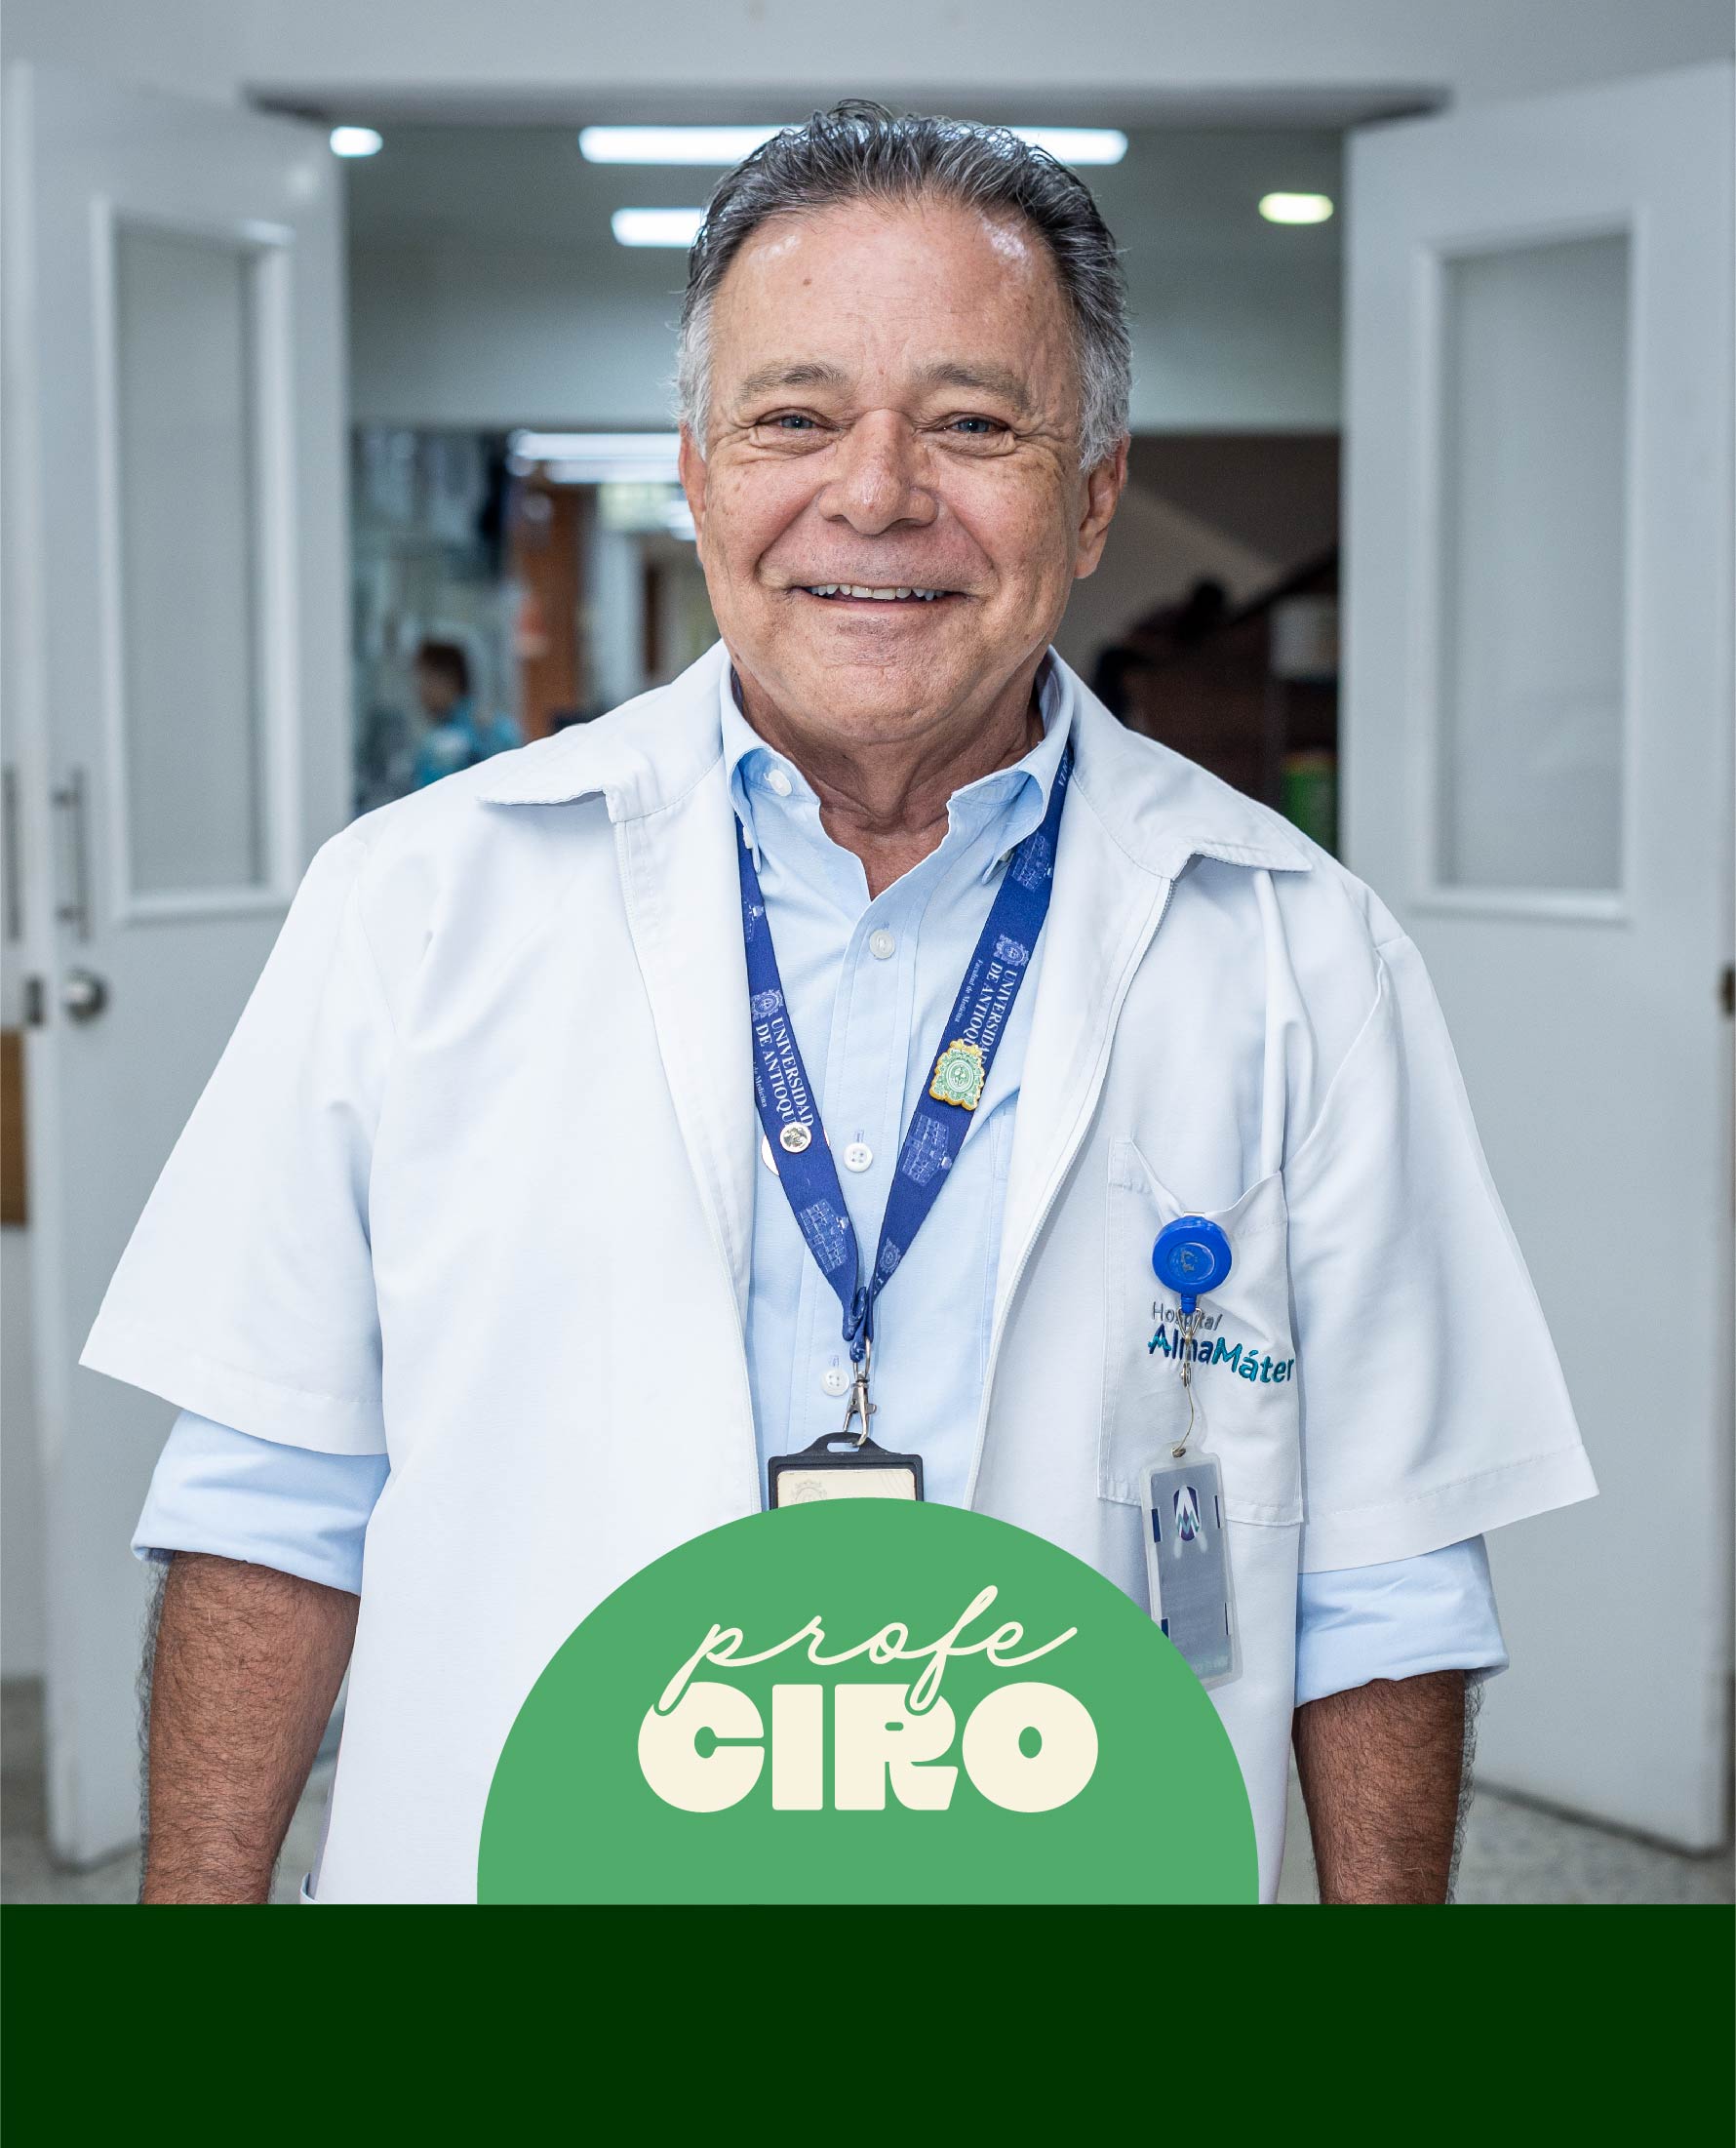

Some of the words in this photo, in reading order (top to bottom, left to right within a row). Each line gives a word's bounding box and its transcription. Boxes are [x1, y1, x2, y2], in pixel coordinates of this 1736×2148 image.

[987, 962, 1003, 984] DE
[755, 1023, 772, 1047] DE
[763, 1050, 797, 1126] ANTIOQU
[770, 1016, 814, 1127] UNIVERSIDAD
